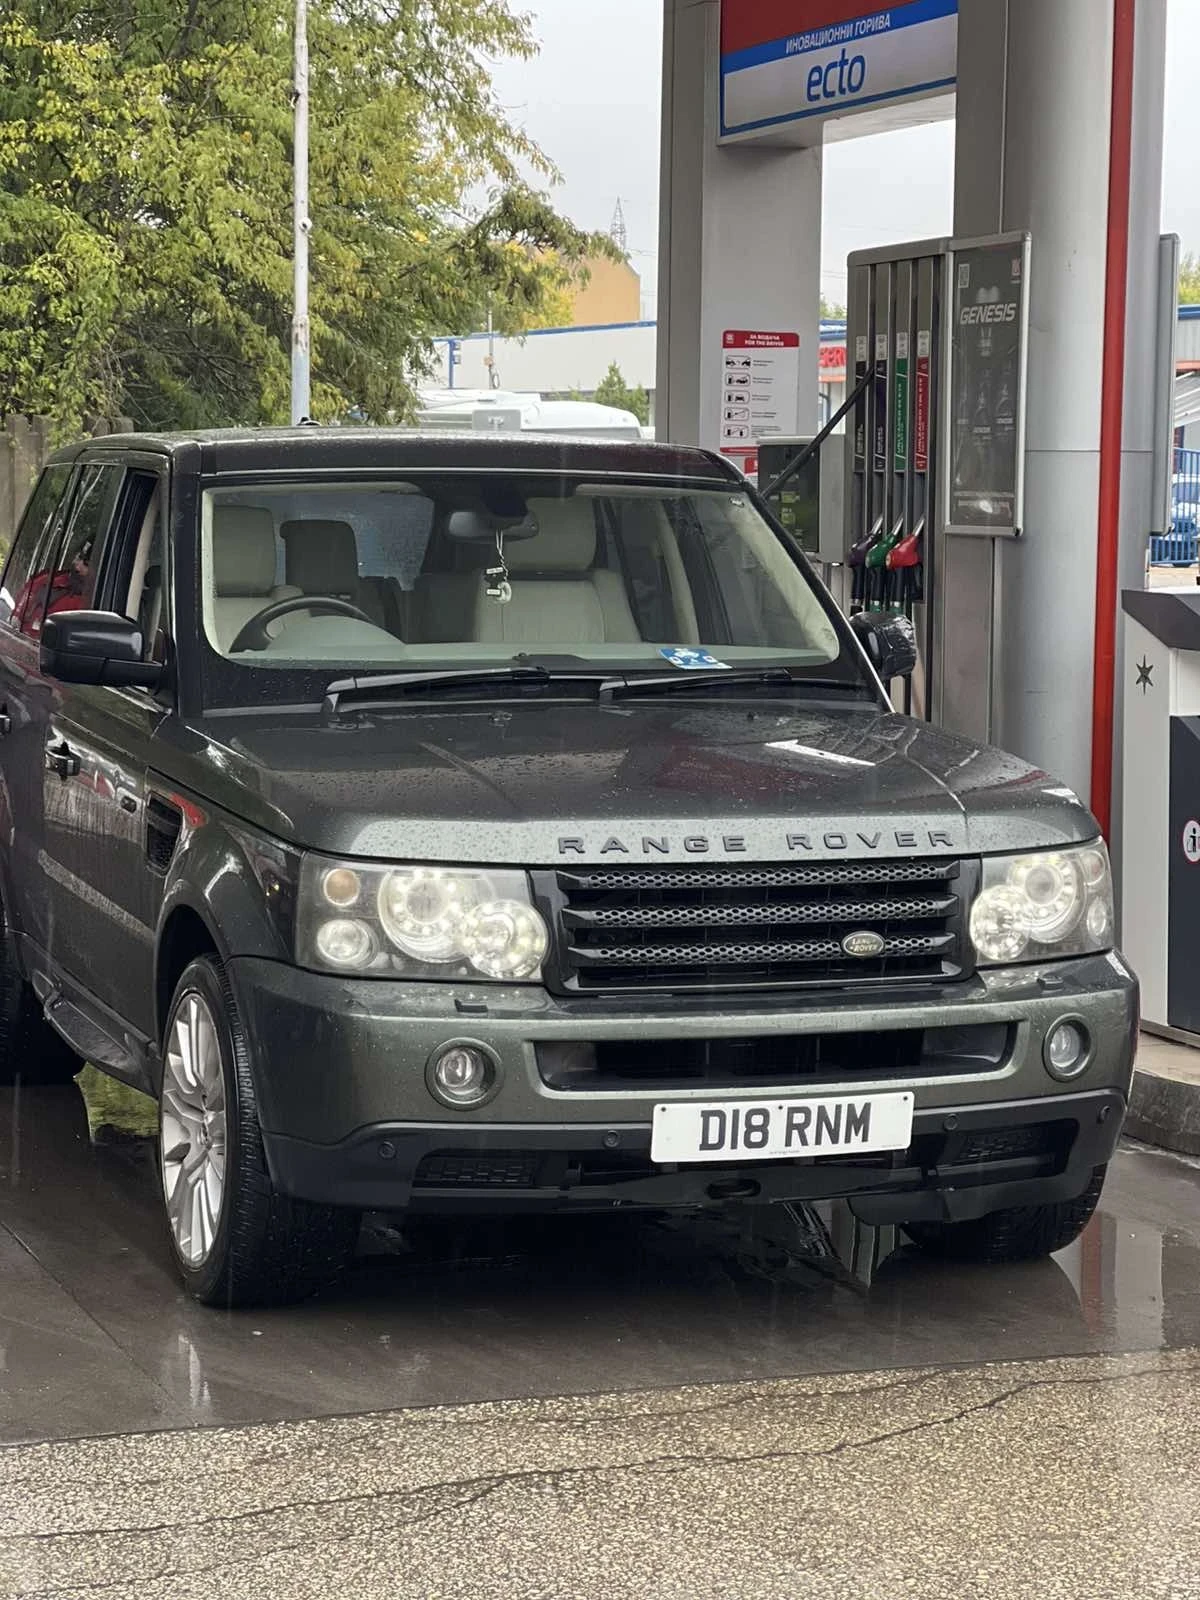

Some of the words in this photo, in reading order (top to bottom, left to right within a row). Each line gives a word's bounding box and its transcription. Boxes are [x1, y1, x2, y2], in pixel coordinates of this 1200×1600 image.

[785, 24, 853, 54] ИНОВАЦИОННИ
[854, 13, 891, 38] ГОРИВА
[806, 48, 866, 102] ecto
[959, 303, 1017, 325] GENESIS
[558, 834, 747, 855] RANGE
[786, 829, 954, 851] ROVER
[785, 1102, 872, 1147] RNM
